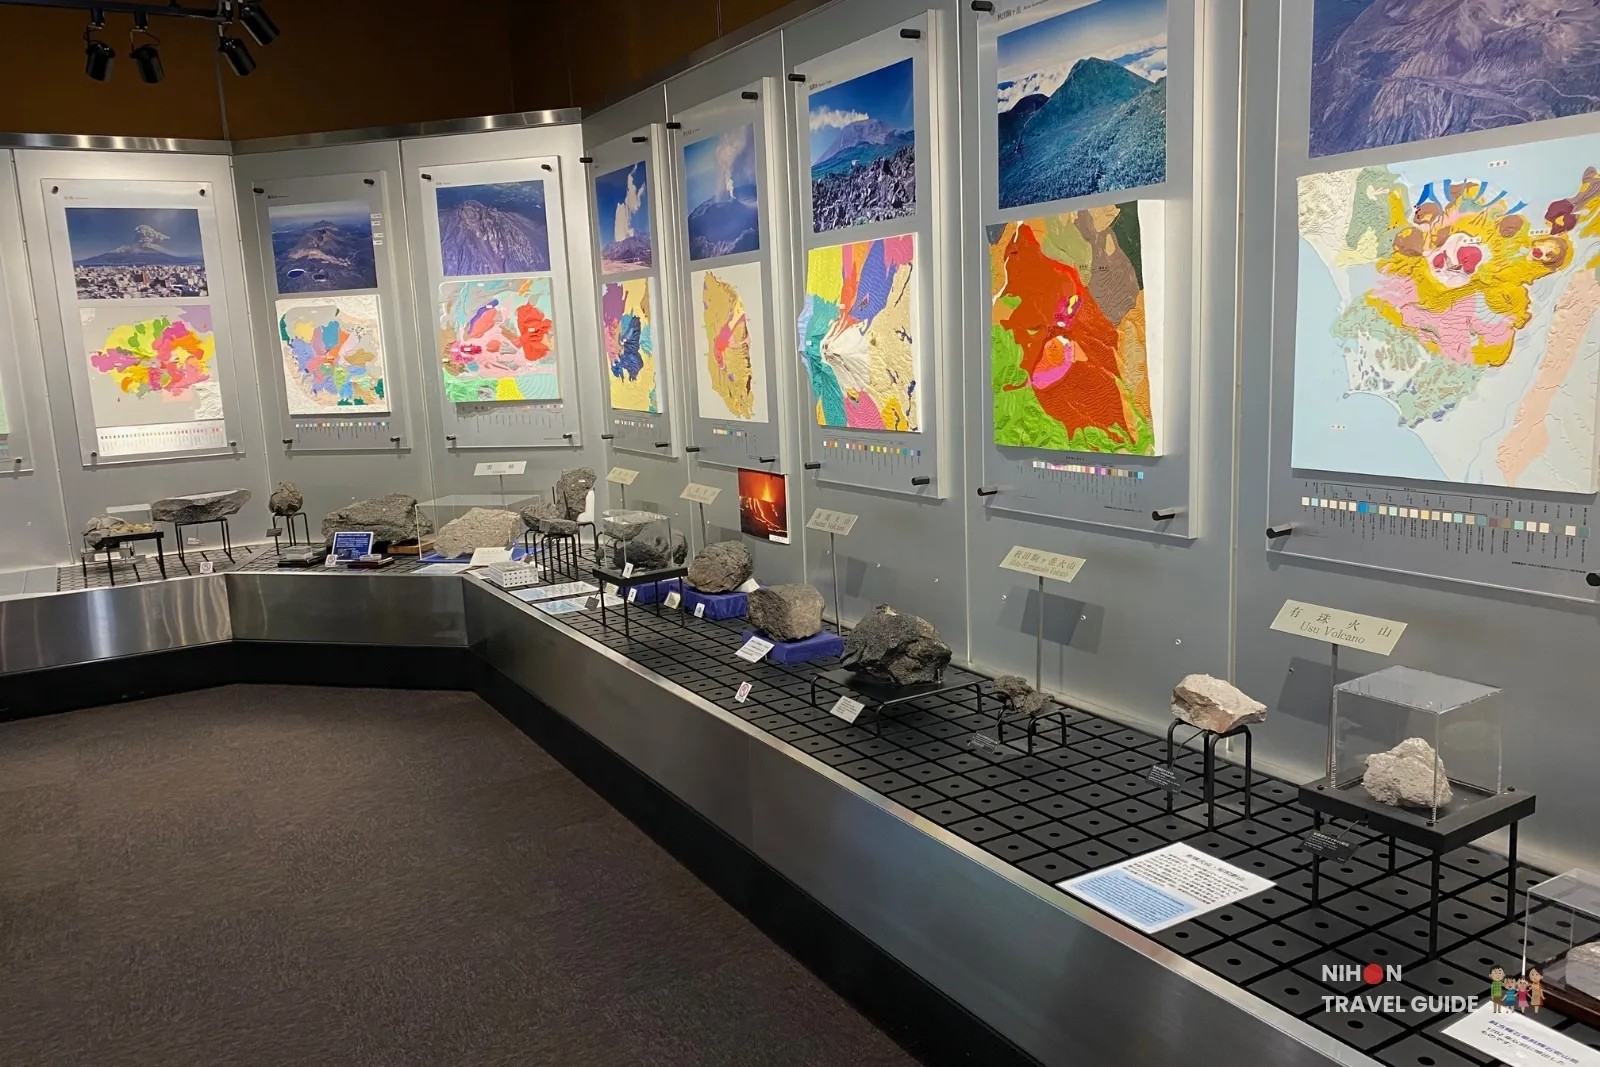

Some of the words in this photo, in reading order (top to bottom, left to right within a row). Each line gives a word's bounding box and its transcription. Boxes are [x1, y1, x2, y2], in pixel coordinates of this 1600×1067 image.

[1289, 606, 1392, 638] 有珠火山
[1299, 621, 1320, 634] Usu
[1323, 626, 1366, 644] Volcano
